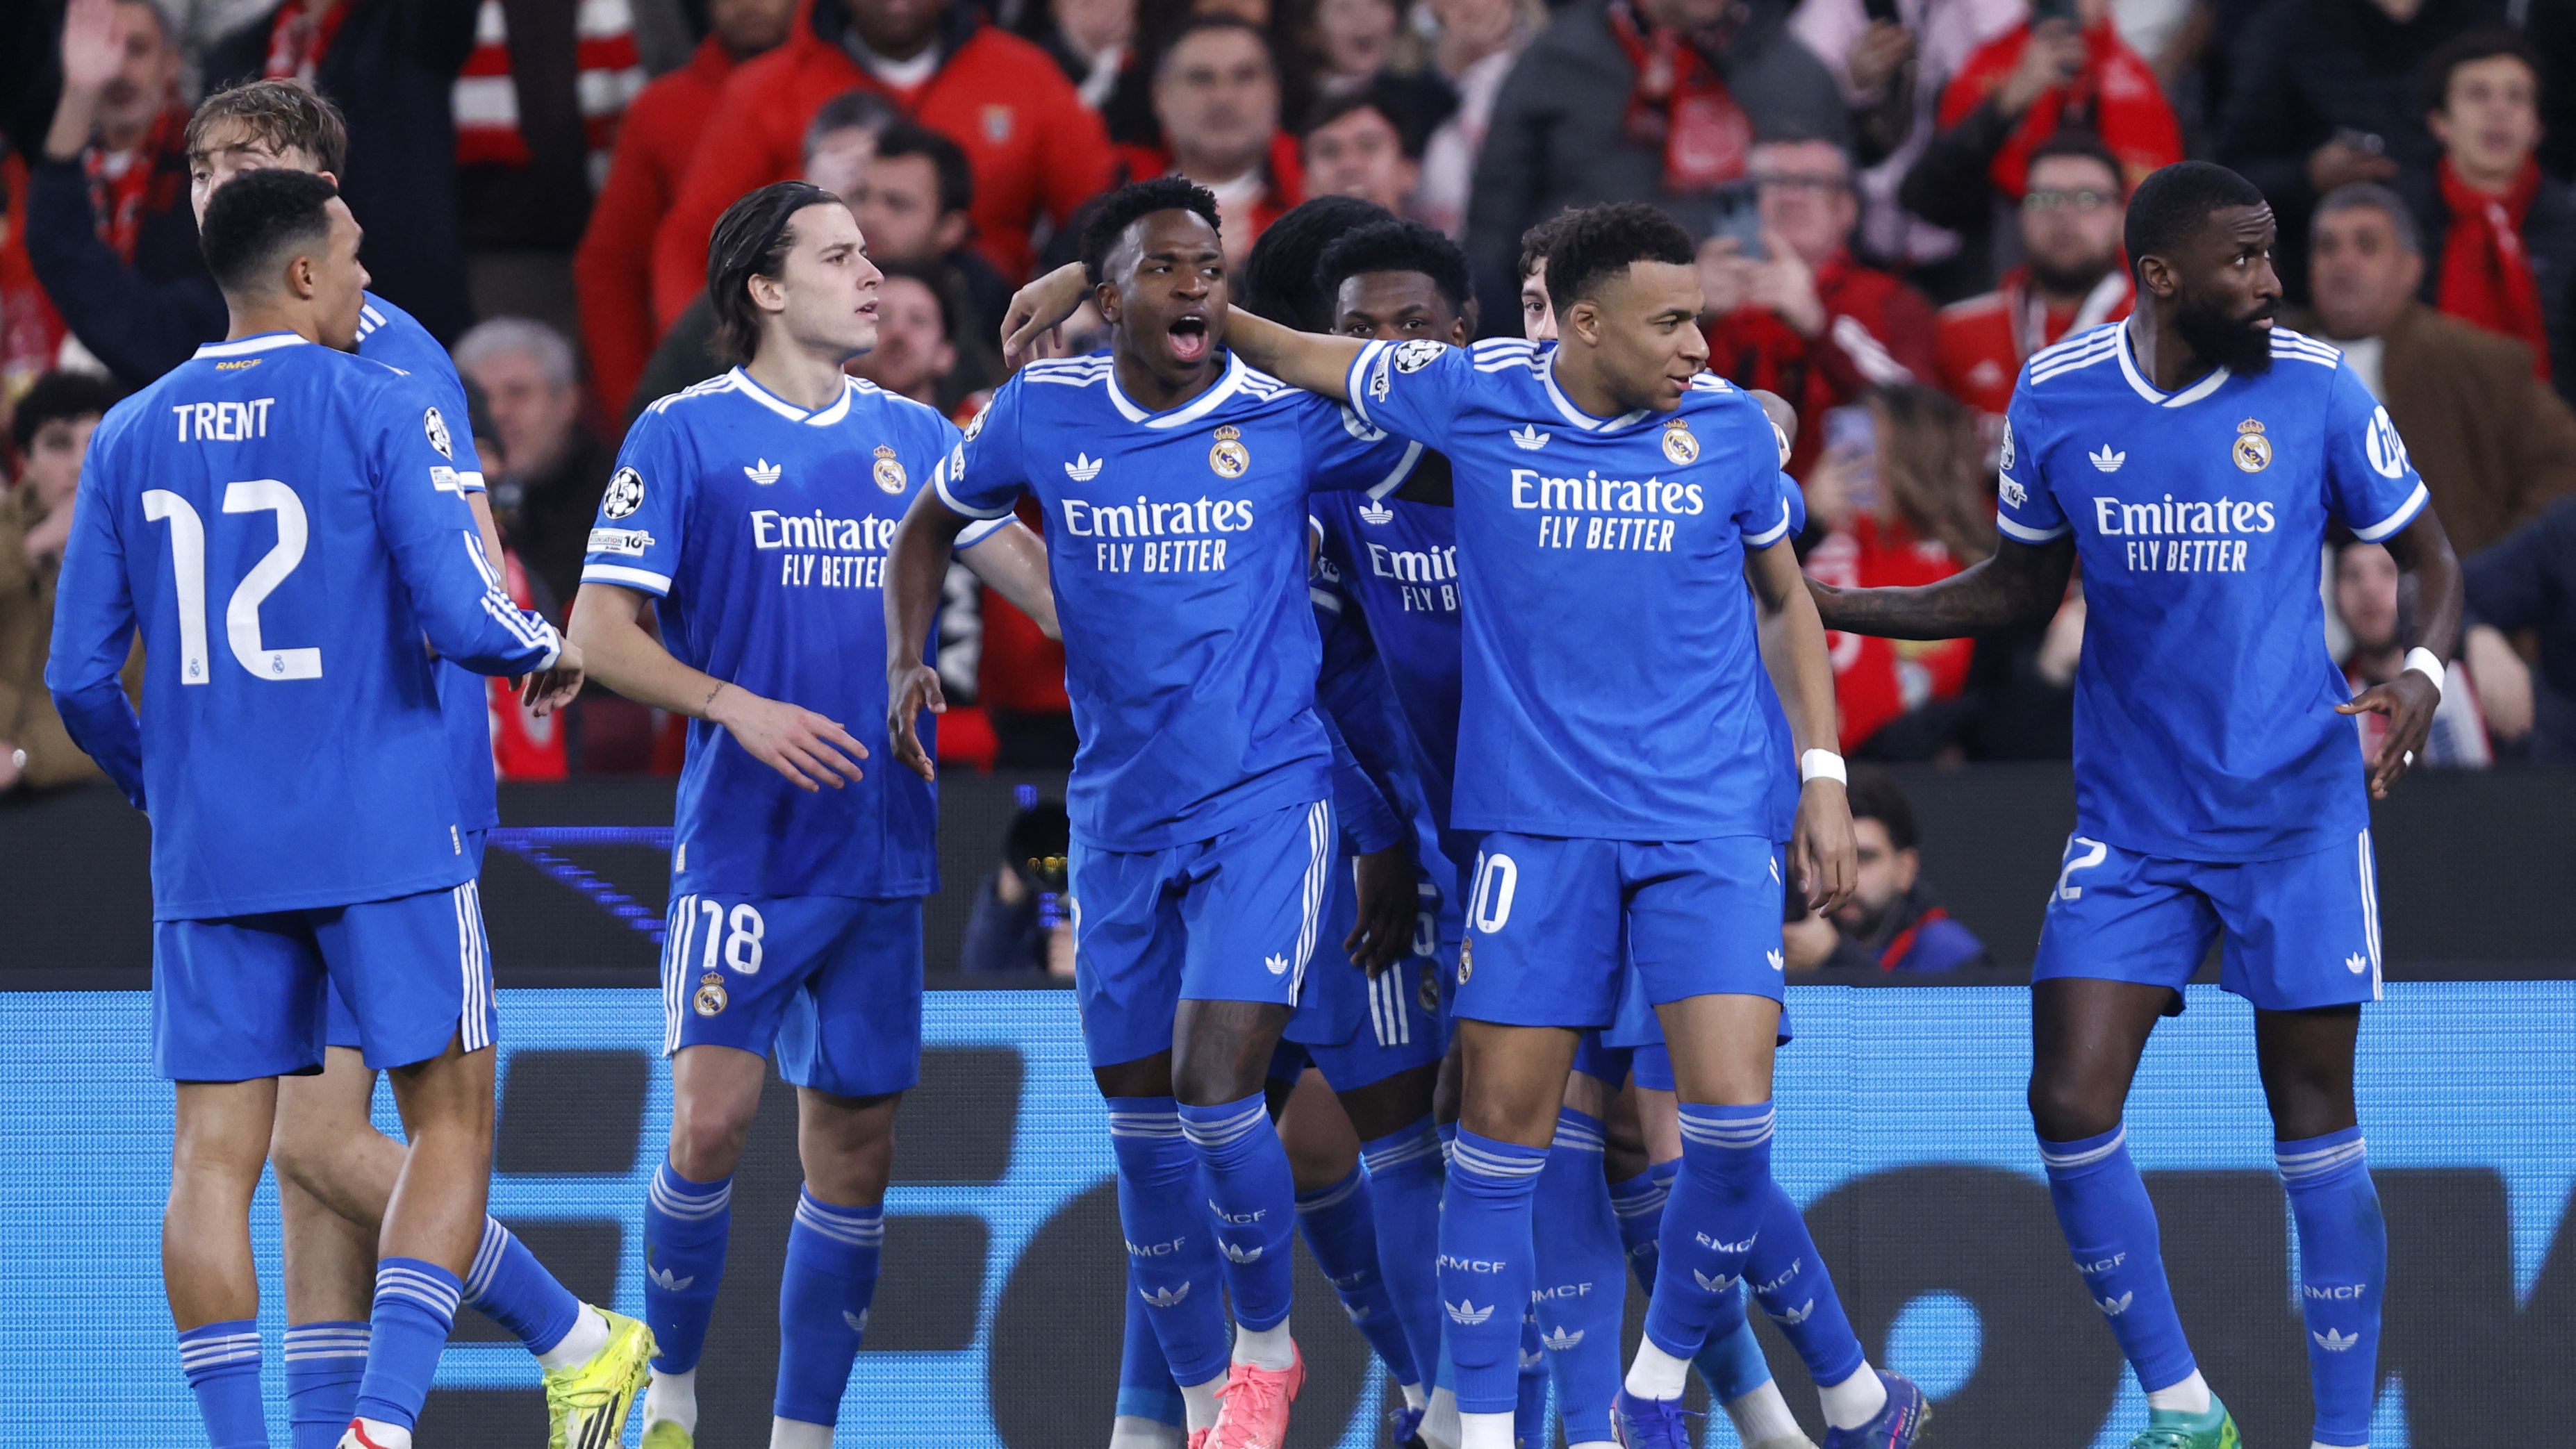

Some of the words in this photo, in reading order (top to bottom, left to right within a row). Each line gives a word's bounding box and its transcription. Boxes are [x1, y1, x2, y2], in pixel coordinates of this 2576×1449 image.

[215, 358, 263, 370] RMCF
[172, 397, 275, 442] TRENT
[1510, 469, 1704, 515] Emirates
[750, 509, 902, 549] Emirate
[1062, 495, 1253, 537] Emirates
[2092, 493, 2275, 535] Emirates
[1539, 515, 1579, 549] FLY
[1586, 517, 1676, 552] BETTER
[782, 554, 815, 586] FLY
[1097, 543, 1134, 572] FLY
[1143, 539, 1226, 573] BETTER
[2127, 540, 2161, 572] FLY
[2166, 540, 2248, 572] BETTER
[141, 479, 323, 684] 12
[1401, 586, 1433, 611] FLY
[702, 900, 764, 974] 18
[1750, 1257, 1801, 1294] MCF
[2073, 1252, 2127, 1273] MCF
